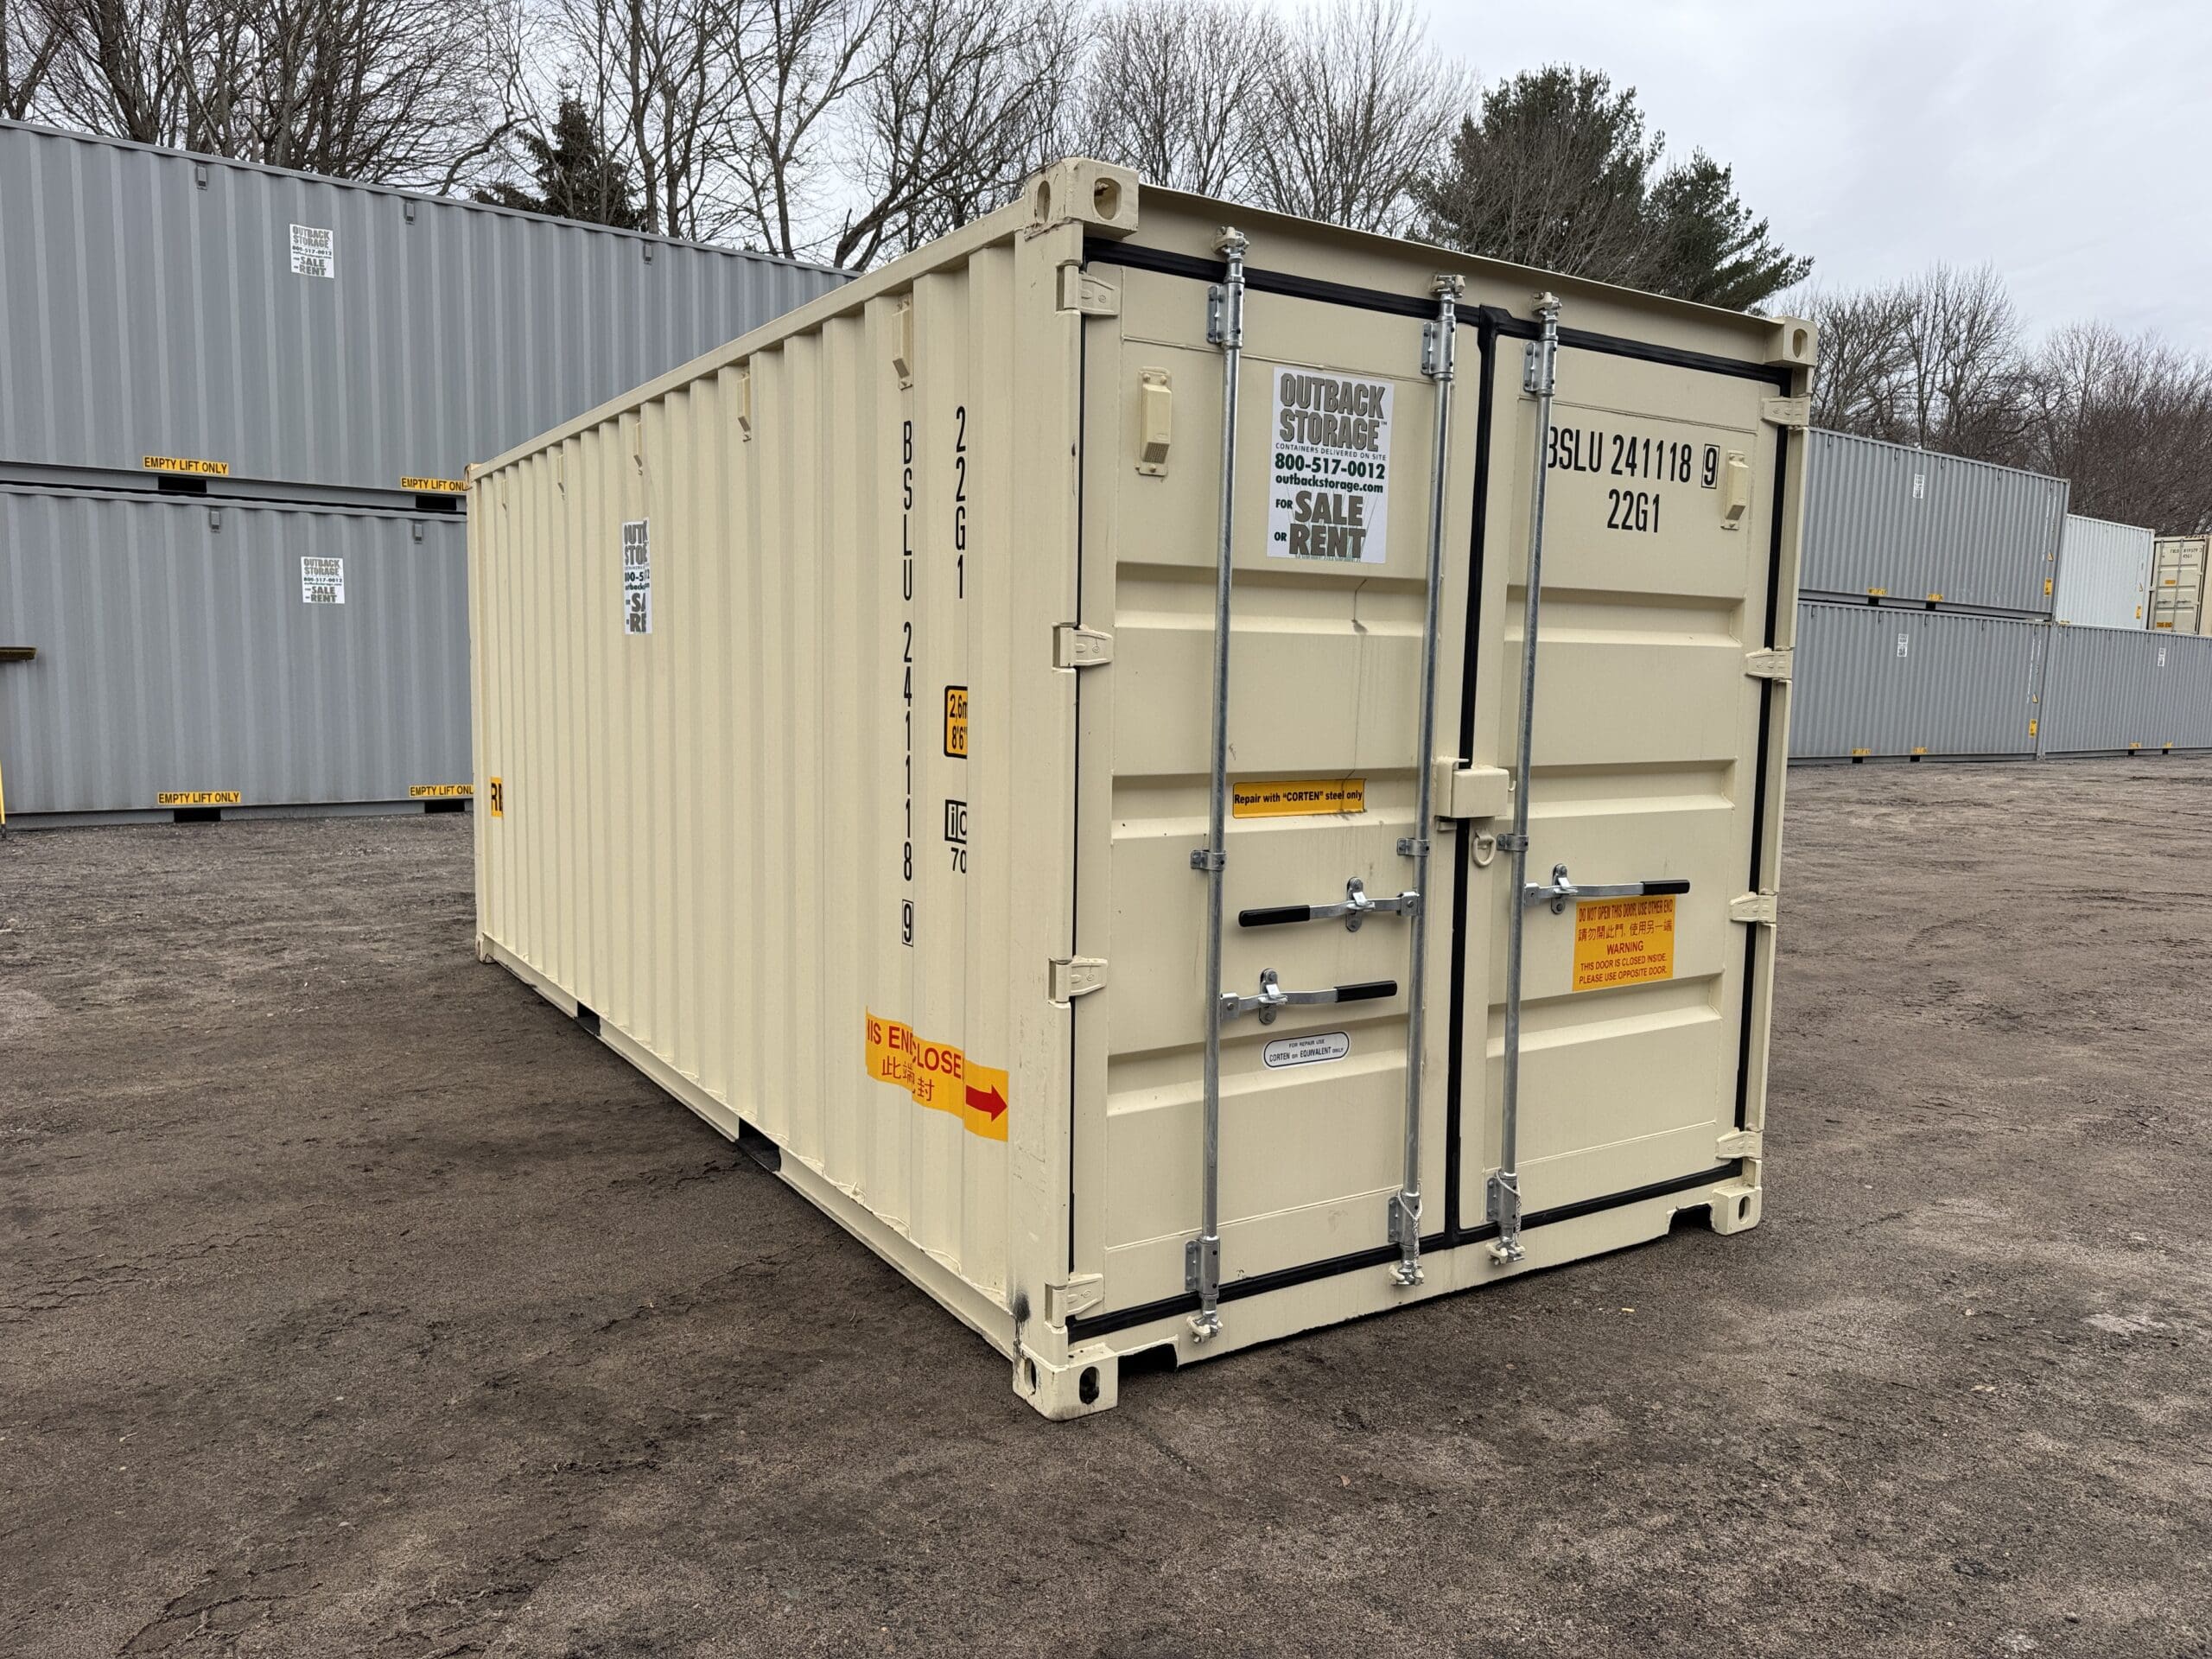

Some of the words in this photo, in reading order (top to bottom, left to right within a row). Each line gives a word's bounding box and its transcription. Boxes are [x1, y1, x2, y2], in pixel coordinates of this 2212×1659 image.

[293, 226, 330, 240] OUTBACK
[293, 235, 329, 249] STORAGE
[299, 264, 327, 276] RENT
[301, 256, 325, 268] SALE
[1280, 372, 1385, 419] OUTBACK
[1280, 408, 1380, 452] STORAGE
[1275, 442, 1319, 454] CONTAINERS
[1320, 448, 1357, 458] DELIVERED
[144, 457, 176, 470] EMPTY
[180, 460, 199, 472] LIFT
[202, 462, 227, 474] ONLY
[1275, 453, 1385, 480] 800-517-0012
[1611, 434, 1692, 483] 241118
[1704, 448, 1718, 486] 9
[401, 478, 429, 489] EMPTY
[432, 480, 448, 490] LIFT
[449, 482, 467, 491] ONL
[1275, 473, 1383, 493] outbackstorage.com
[904, 420, 912, 601] BSLU
[956, 406, 966, 599] 22G1
[1275, 499, 1293, 510] FOR
[1294, 490, 1363, 526] SALE
[1607, 489, 1660, 532] 22G1
[1274, 532, 1287, 542] OR
[1289, 523, 1366, 558] RENT
[304, 558, 340, 569] OUTBACK
[304, 567, 339, 575] STORAGE
[311, 586, 335, 594] SALE
[311, 594, 337, 603] RENT
[904, 622, 912, 881] 241118
[159, 793, 190, 804] EMPTY
[193, 793, 213, 803] LIFT
[214, 792, 238, 802] ONLY
[410, 786, 437, 796] EMPTY
[439, 786, 454, 795] LIFT
[456, 785, 474, 795] ONL
[1234, 794, 1261, 805] Repair
[1263, 793, 1281, 803] with
[1325, 790, 1344, 800] steel
[1346, 790, 1362, 801] only
[950, 847, 966, 874] 70
[1579, 907, 1586, 923] DO
[1586, 907, 1597, 921] NOT
[1599, 906, 1611, 920] OPEN
[1612, 904, 1623, 918] THIS
[1638, 901, 1647, 916] USE
[1649, 900, 1662, 914] OTHER
[1664, 899, 1673, 912] END
[1607, 940, 1643, 956] WARNING
[1580, 963, 1594, 971] THIS
[1595, 959, 1614, 969] DOOR
[1622, 956, 1645, 966] CLOSED
[1580, 973, 1603, 983] PLEASE
[1605, 971, 1617, 981] USE
[1618, 968, 1648, 979] OPPOSITE
[1269, 1052, 1290, 1063] CORTEN
[1300, 1046, 1331, 1058] EQUIVALENT
